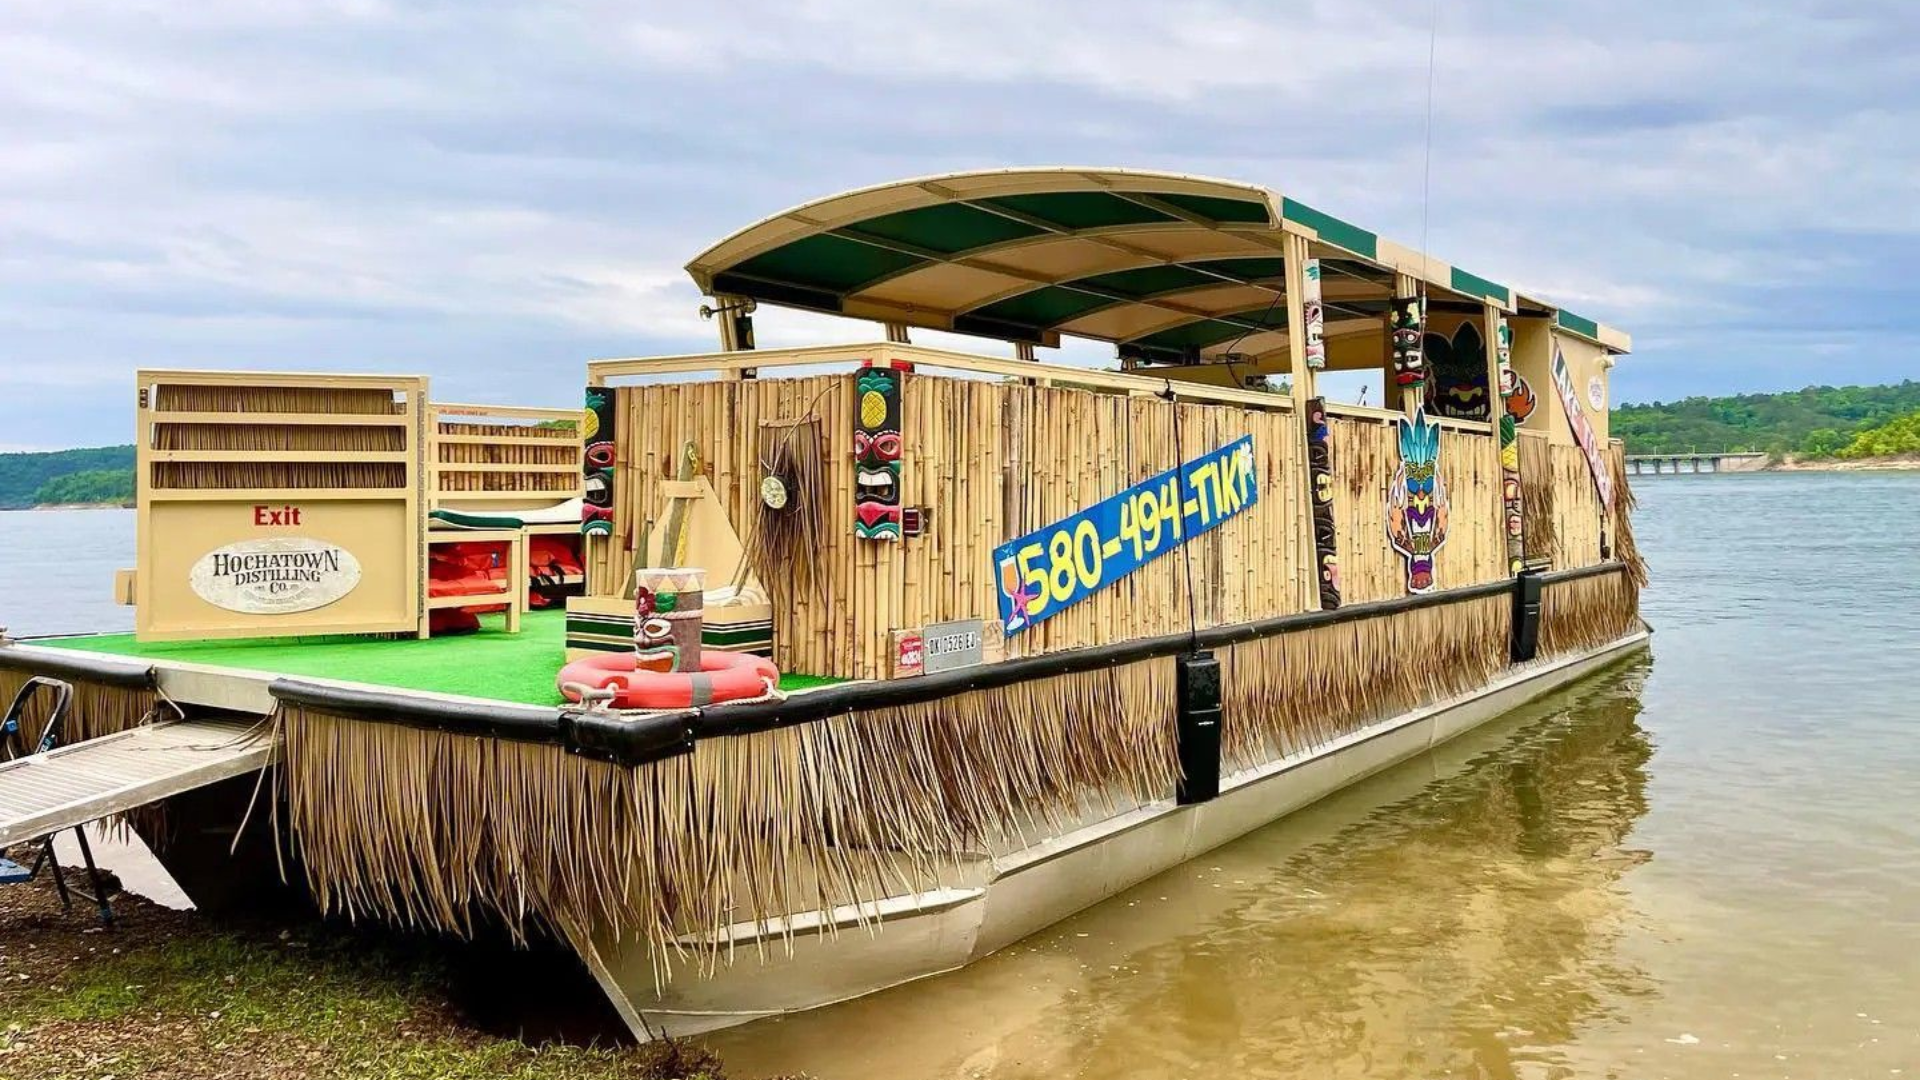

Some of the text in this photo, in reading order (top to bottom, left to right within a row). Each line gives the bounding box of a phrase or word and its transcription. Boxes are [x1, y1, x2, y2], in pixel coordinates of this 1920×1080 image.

[254, 504, 301, 525] Exit
[213, 549, 339, 577] HOCHATOWN
[235, 568, 321, 586] DISTILLING
[928, 638, 940, 655] OK
